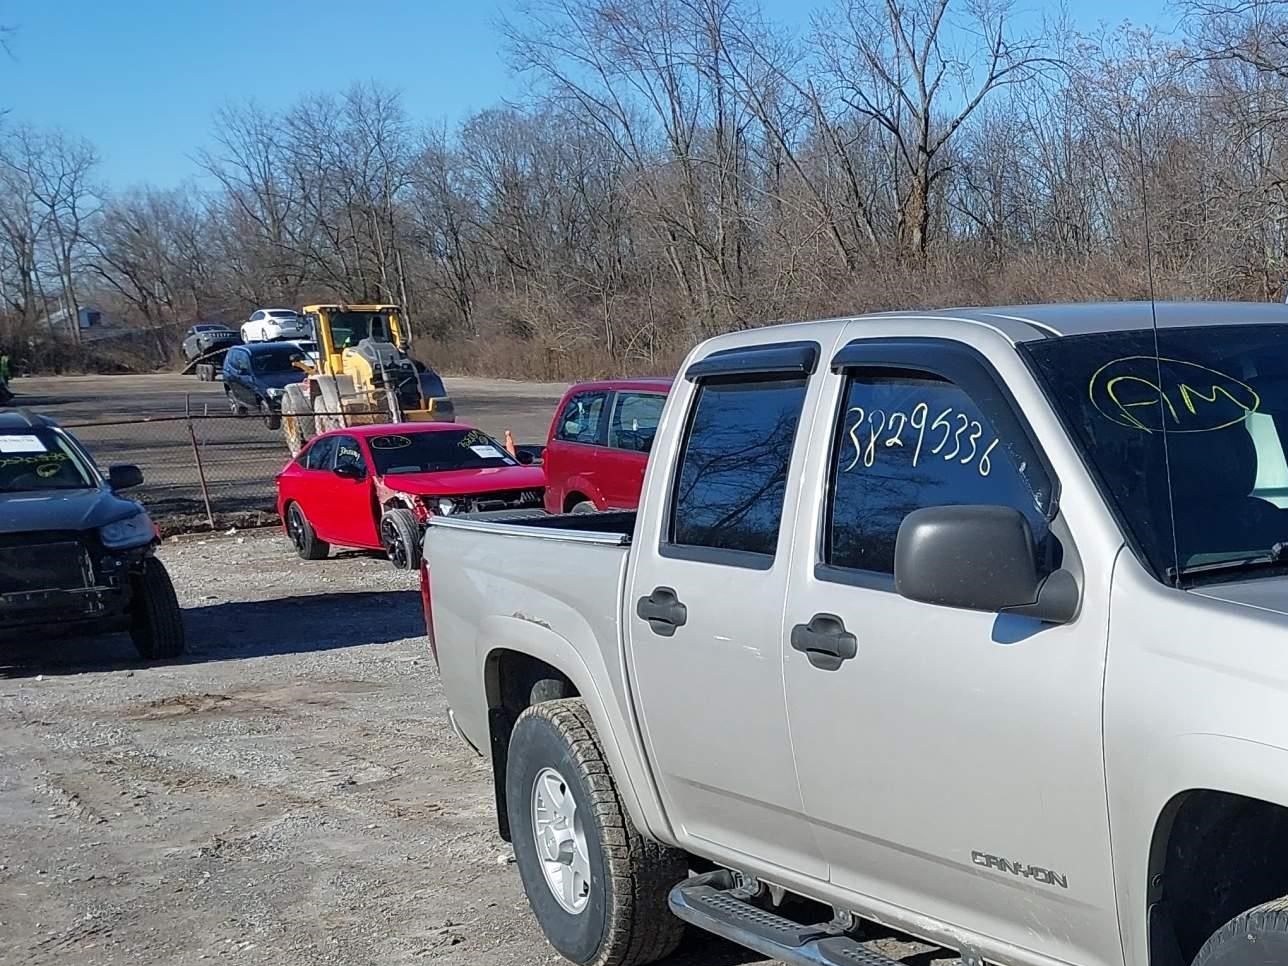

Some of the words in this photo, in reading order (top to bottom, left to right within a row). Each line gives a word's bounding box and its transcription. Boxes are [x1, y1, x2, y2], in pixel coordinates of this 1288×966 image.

[1107, 376, 1249, 434] AM
[844, 403, 999, 476] 38295336
[971, 850, 1068, 888] CANYON
